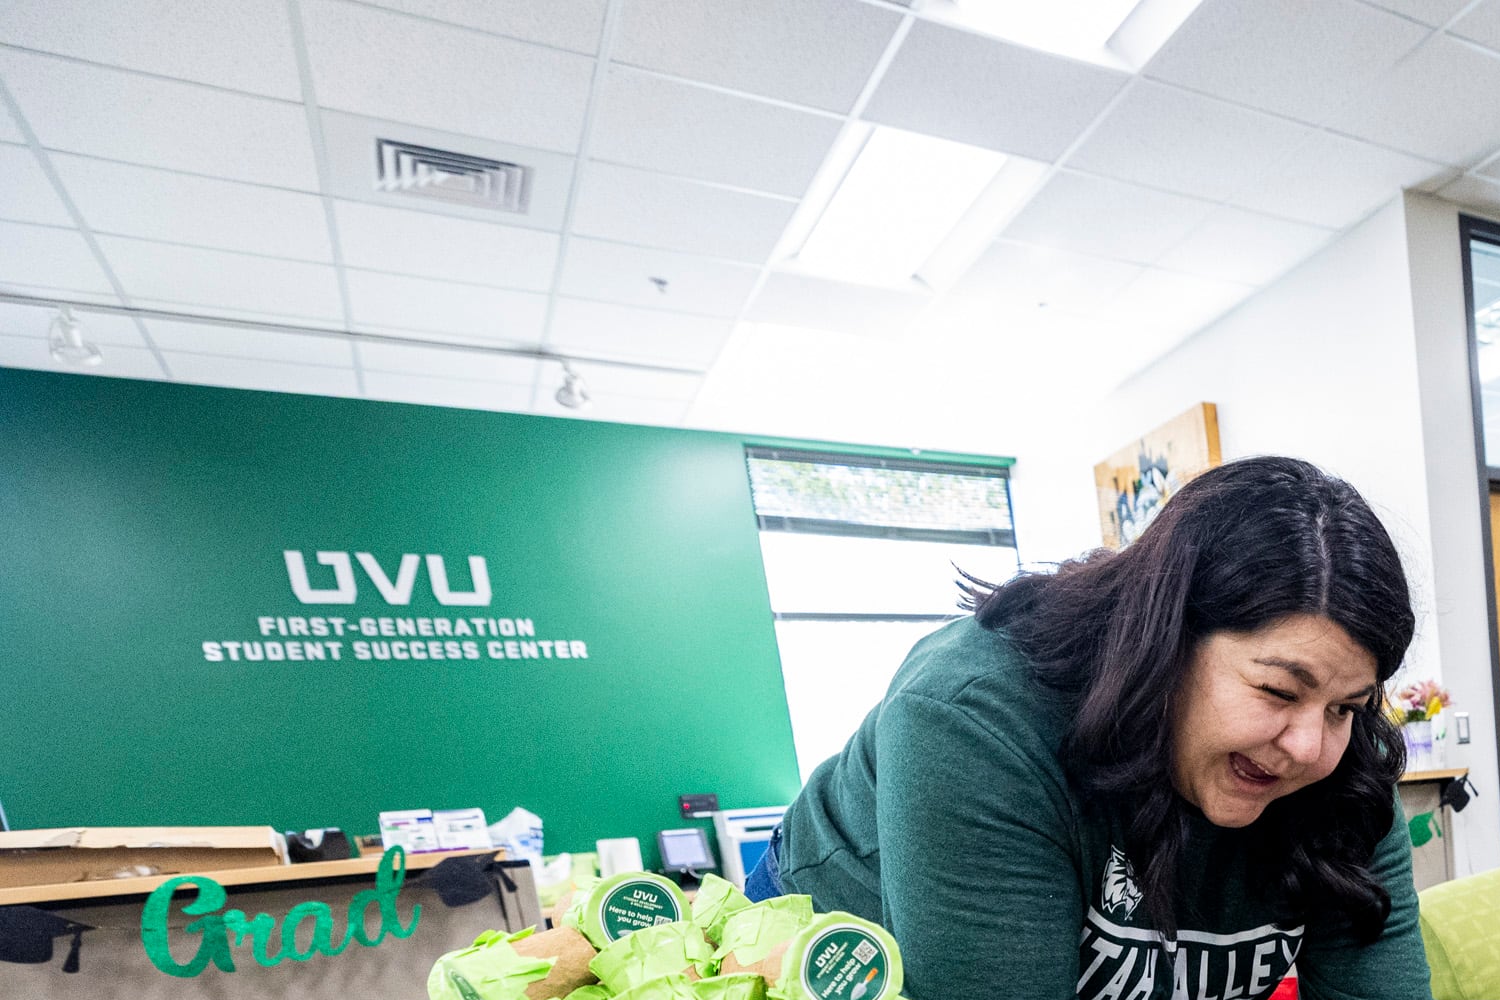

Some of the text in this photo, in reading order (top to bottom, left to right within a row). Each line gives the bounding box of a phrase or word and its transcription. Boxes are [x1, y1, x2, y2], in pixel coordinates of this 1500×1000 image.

[283, 550, 492, 606] UVU
[257, 616, 536, 637] FIRST-GENERATION
[202, 639, 589, 661] STUDENT SUCCESS CENTER
[633, 889, 658, 903] UVU
[141, 845, 422, 978] Grad
[608, 905, 653, 922] Here to help
[617, 915, 632, 924] you
[815, 942, 839, 968] UVU
[821, 980, 837, 998] Here
[834, 973, 843, 982] to
[840, 958, 856, 974] help
[834, 980, 848, 995] you
[845, 962, 862, 982] grow
